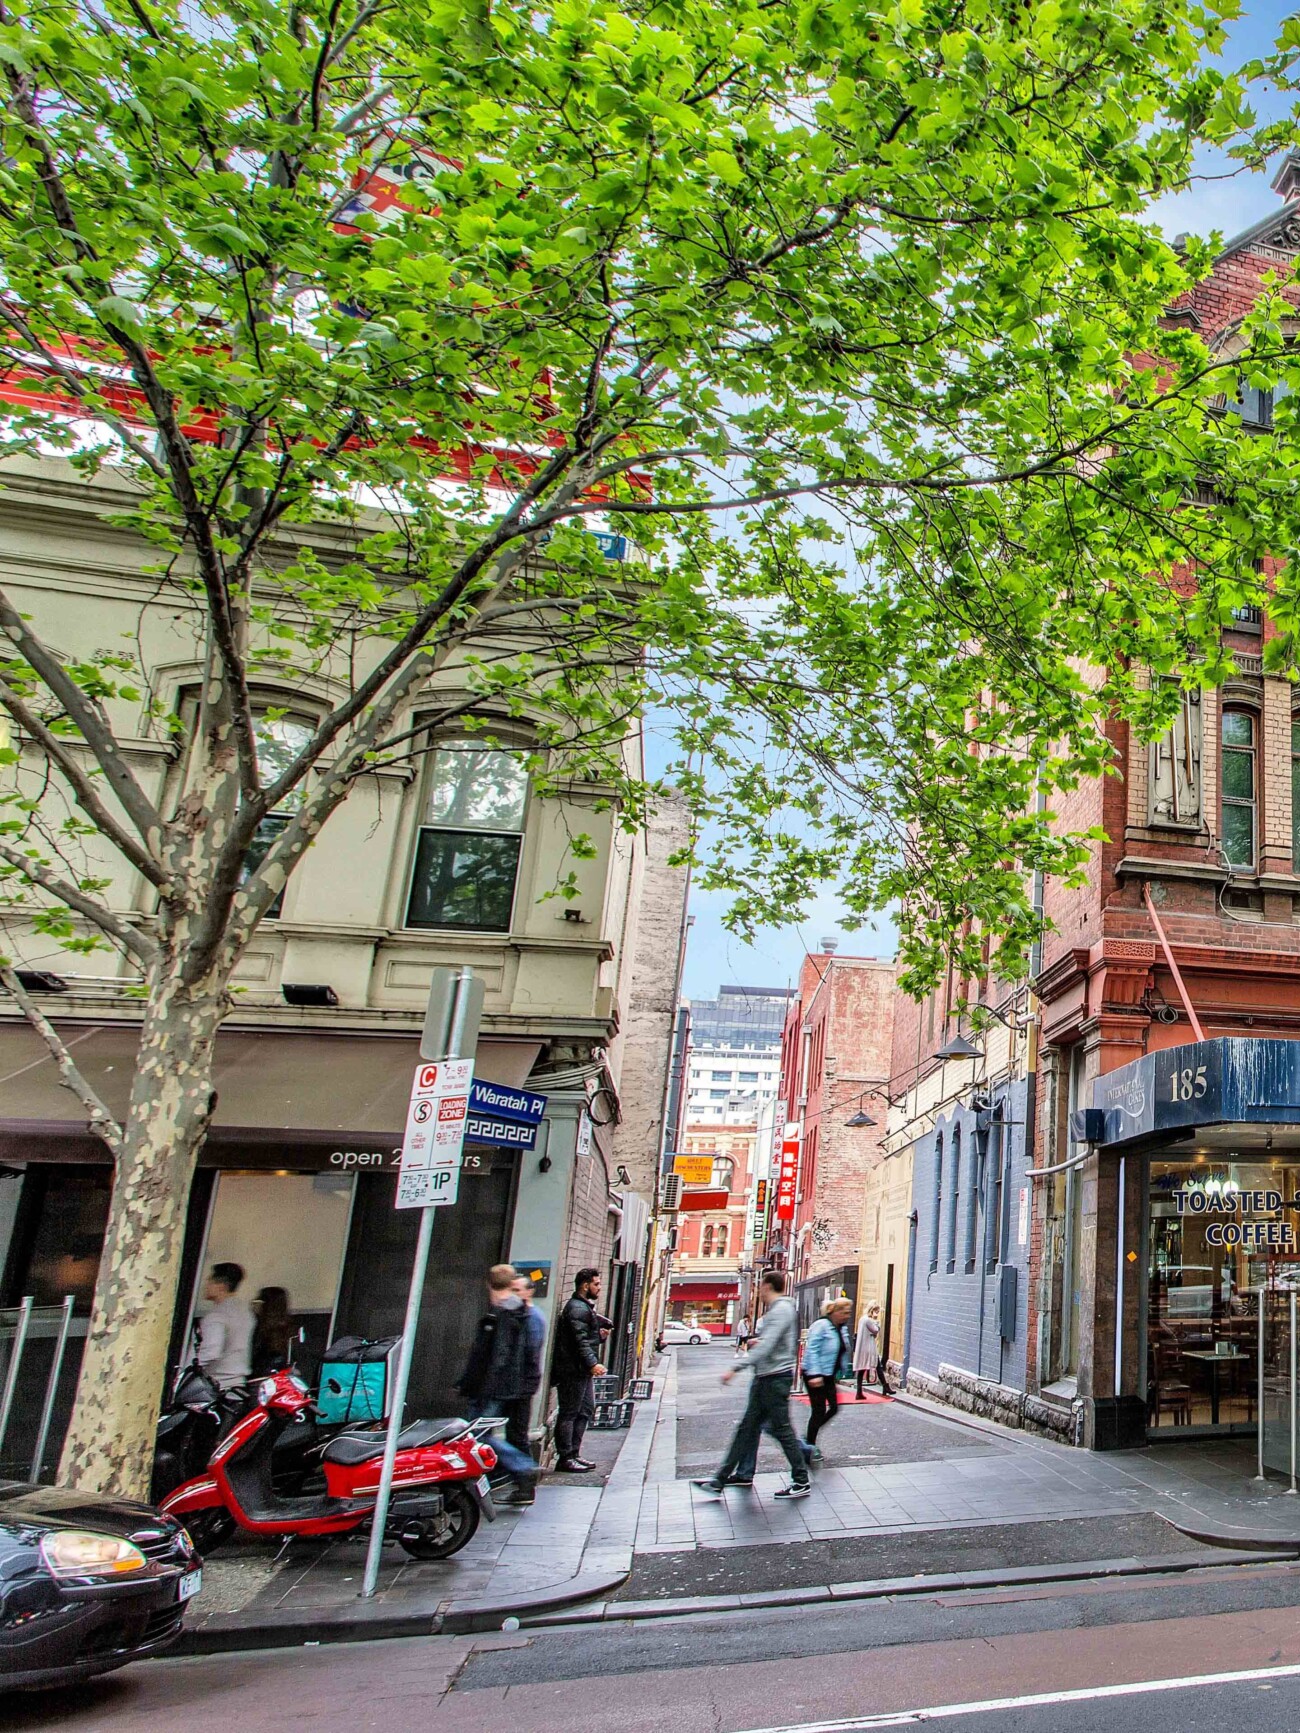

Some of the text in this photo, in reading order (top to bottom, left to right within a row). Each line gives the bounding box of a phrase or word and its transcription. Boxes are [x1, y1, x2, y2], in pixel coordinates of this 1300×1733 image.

[1170, 1065, 1208, 1103] 185
[440, 1098, 466, 1109] LOADING
[476, 1086, 545, 1115] Waratah Pl
[440, 1109, 464, 1119] ZONE
[330, 1151, 383, 1170] open
[432, 1172, 451, 1190] 1P
[1172, 1190, 1284, 1214] TOASTED
[1205, 1223, 1293, 1246] COFFEE
